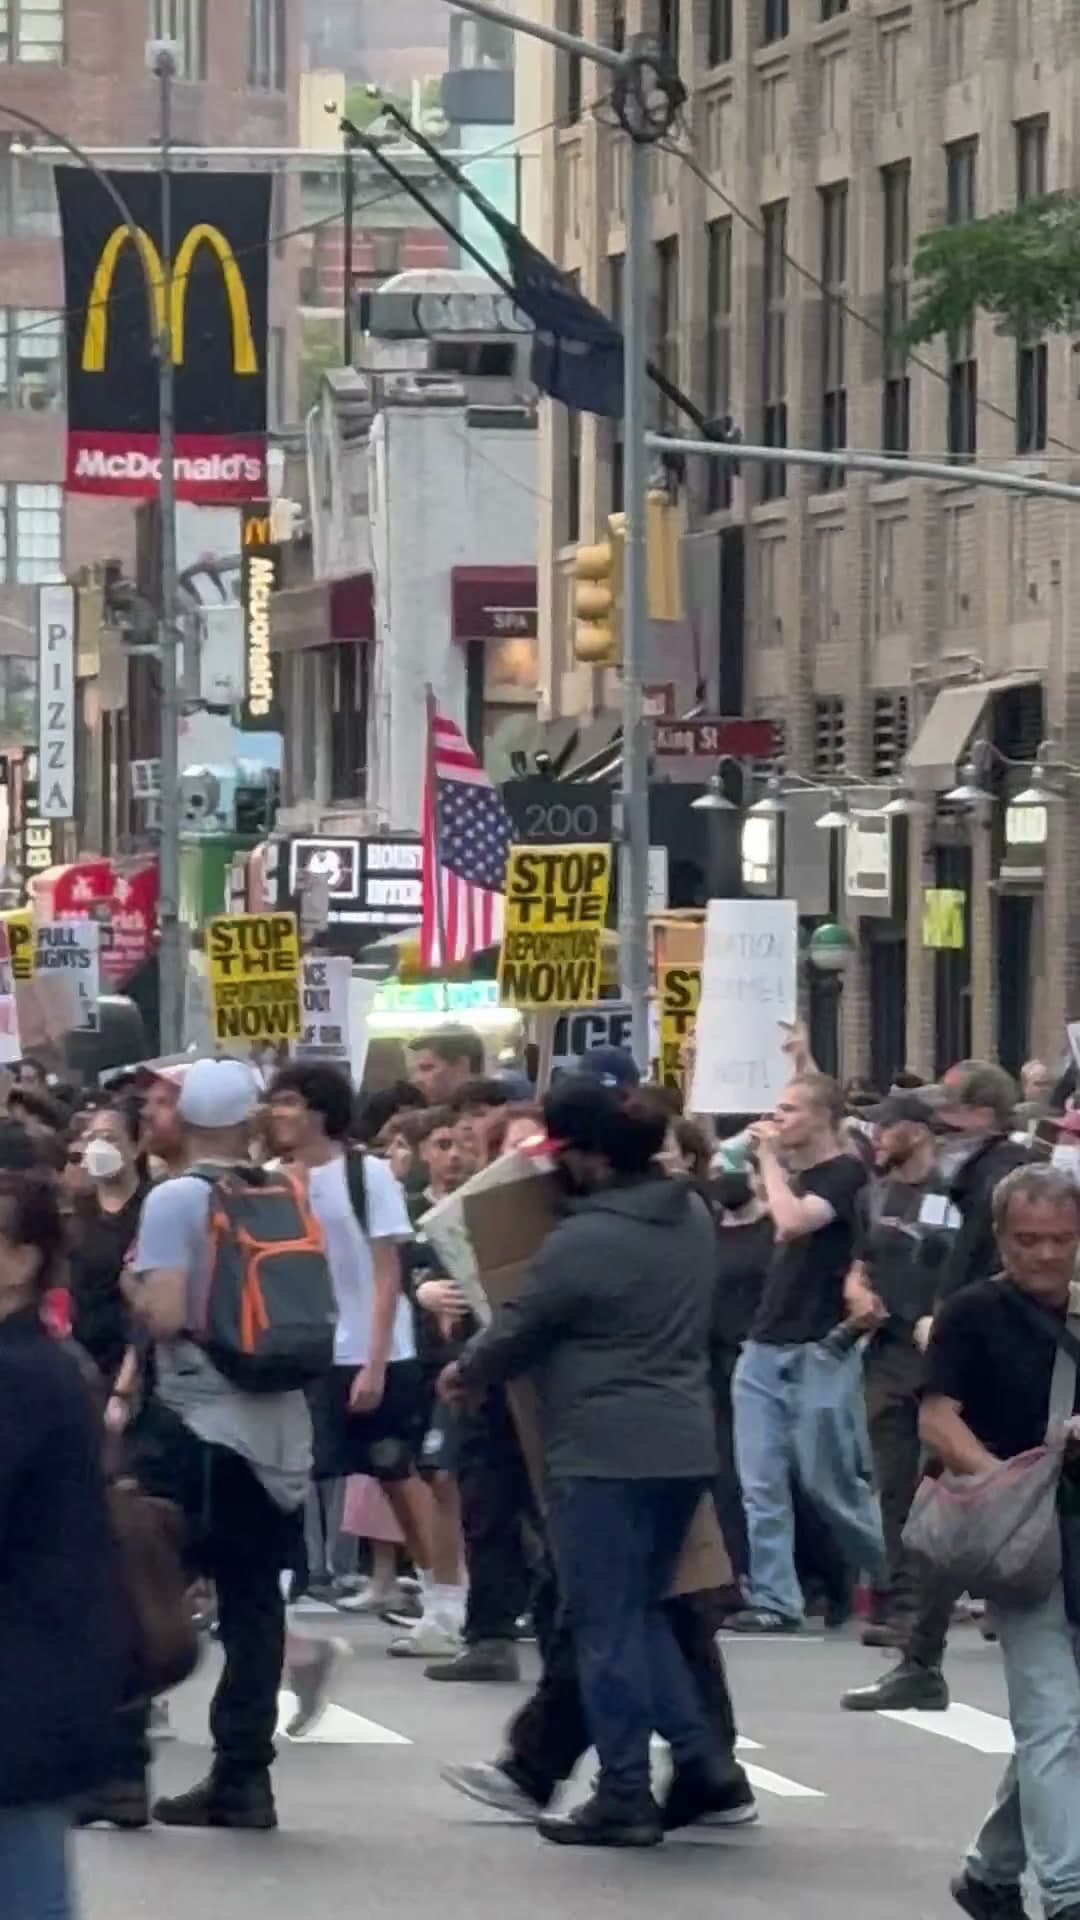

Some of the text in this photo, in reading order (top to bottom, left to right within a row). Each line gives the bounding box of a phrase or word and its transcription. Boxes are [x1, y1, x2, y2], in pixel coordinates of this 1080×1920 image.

[493, 613, 528, 629] SPA
[46, 623, 68, 810] PIZZA
[656, 725, 718, 753] King St
[525, 803, 598, 837] 200
[511, 851, 607, 894] STOP
[509, 895, 604, 924] THE
[37, 927, 80, 947] FULL
[210, 917, 293, 952] STOP
[211, 951, 296, 975] THE
[502, 960, 595, 1003] NOW!
[216, 1003, 301, 1038] NOW!
[552, 1014, 633, 1057] ICE
